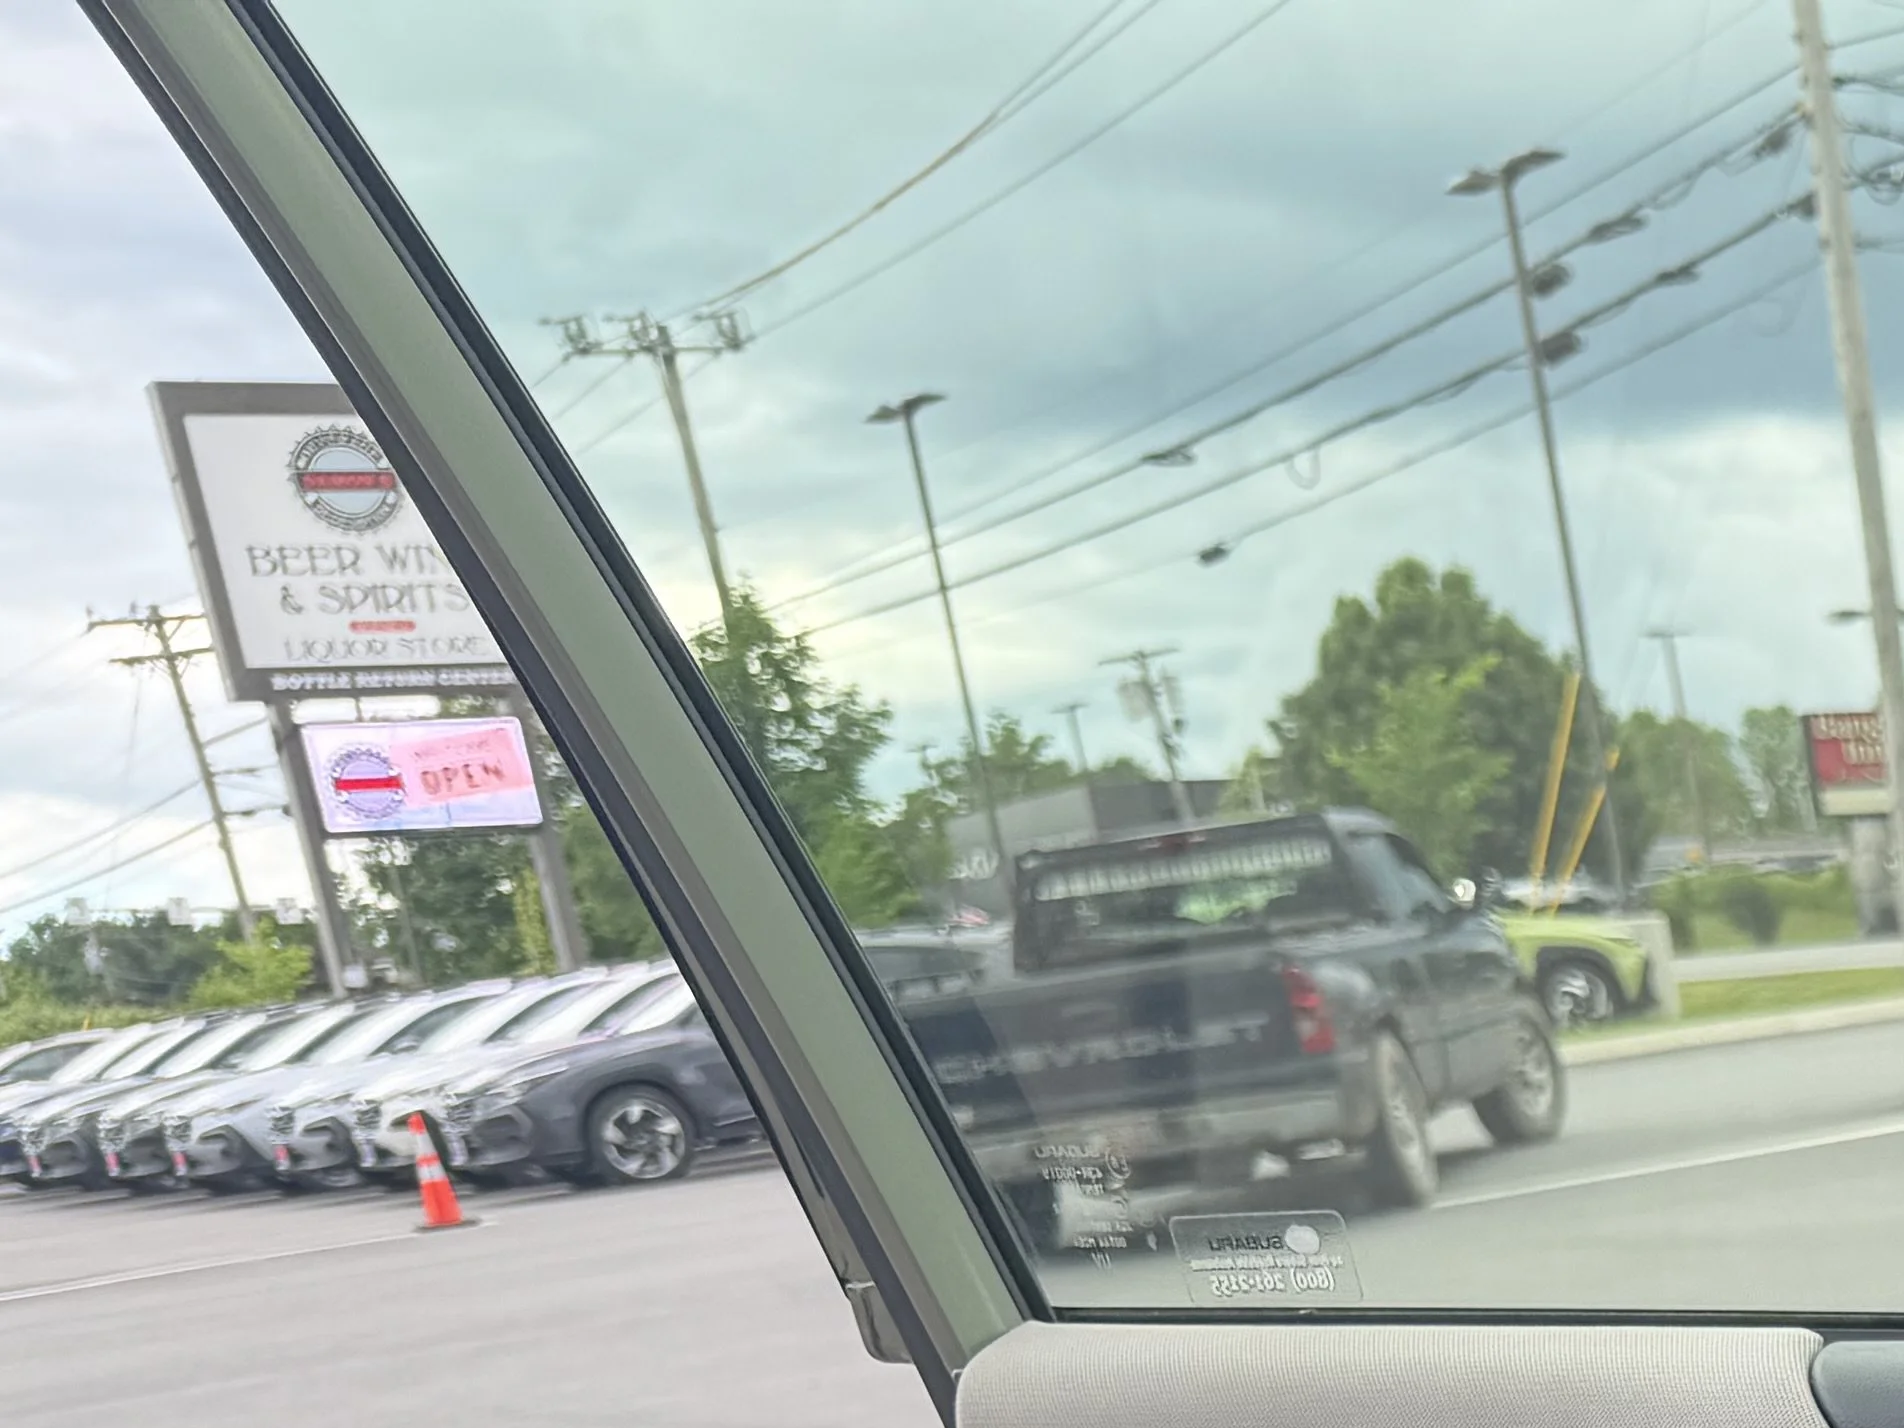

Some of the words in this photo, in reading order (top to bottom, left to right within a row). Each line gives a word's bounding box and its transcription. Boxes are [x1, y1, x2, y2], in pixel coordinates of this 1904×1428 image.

[247, 542, 365, 577] BEER
[375, 543, 452, 576] WIN
[279, 583, 304, 614] &
[318, 583, 471, 615] SPIRITS
[419, 758, 506, 796] OPEN
